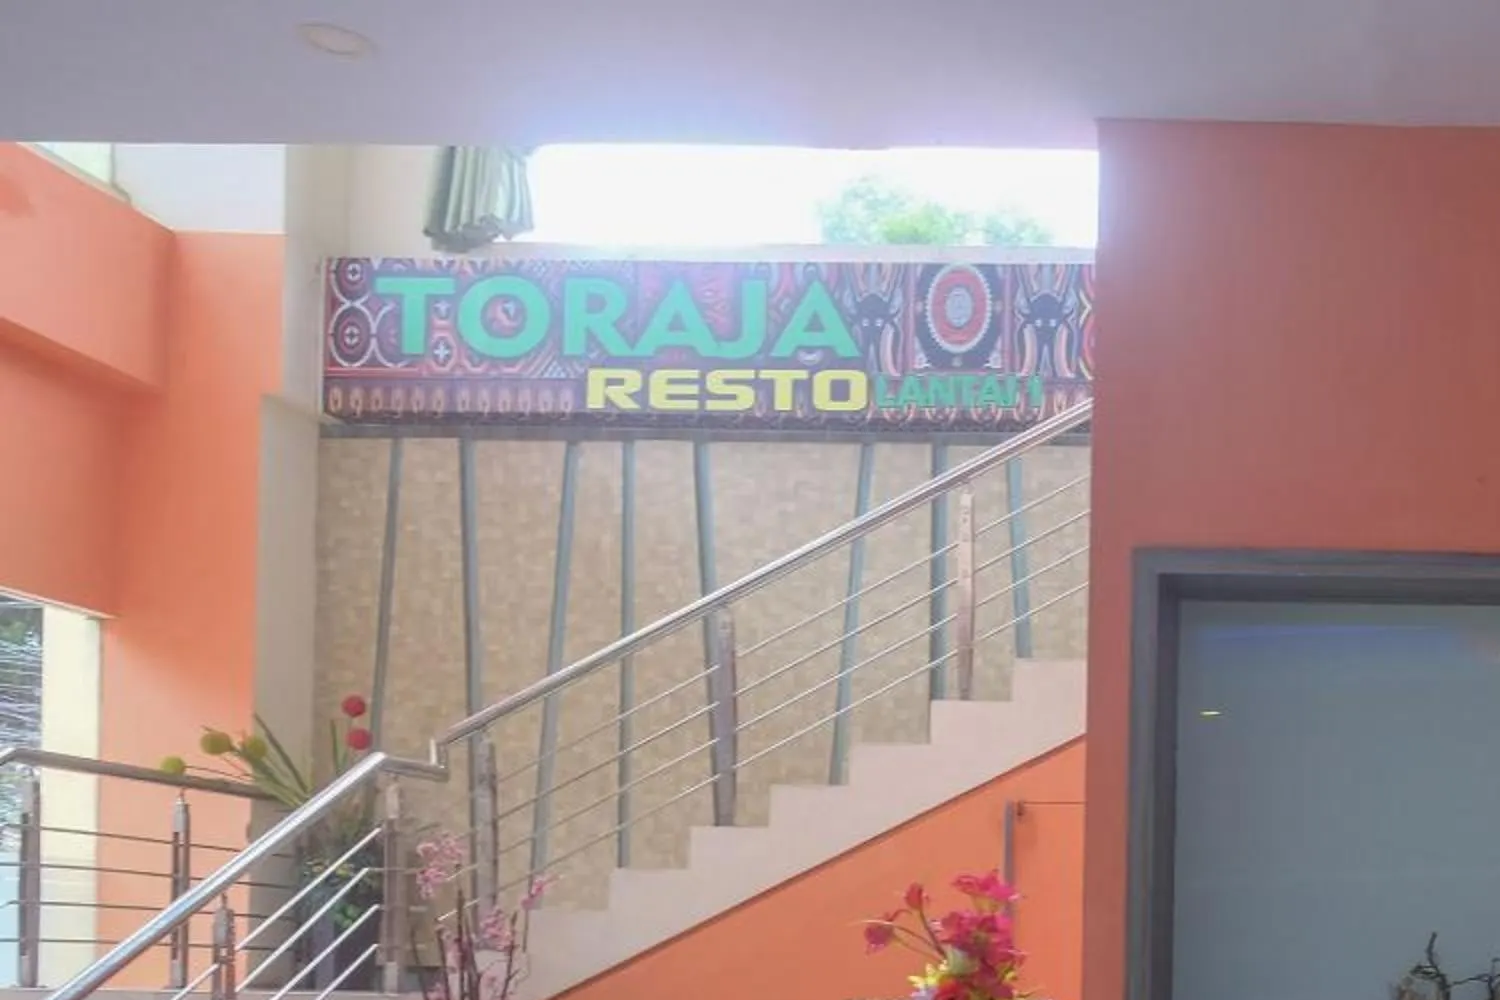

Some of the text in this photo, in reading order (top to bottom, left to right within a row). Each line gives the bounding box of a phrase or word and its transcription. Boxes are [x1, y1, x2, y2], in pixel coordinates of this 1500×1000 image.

[374, 274, 862, 359] TORAJA
[586, 367, 868, 412] RESTO
[876, 374, 1018, 408] LANTAI
